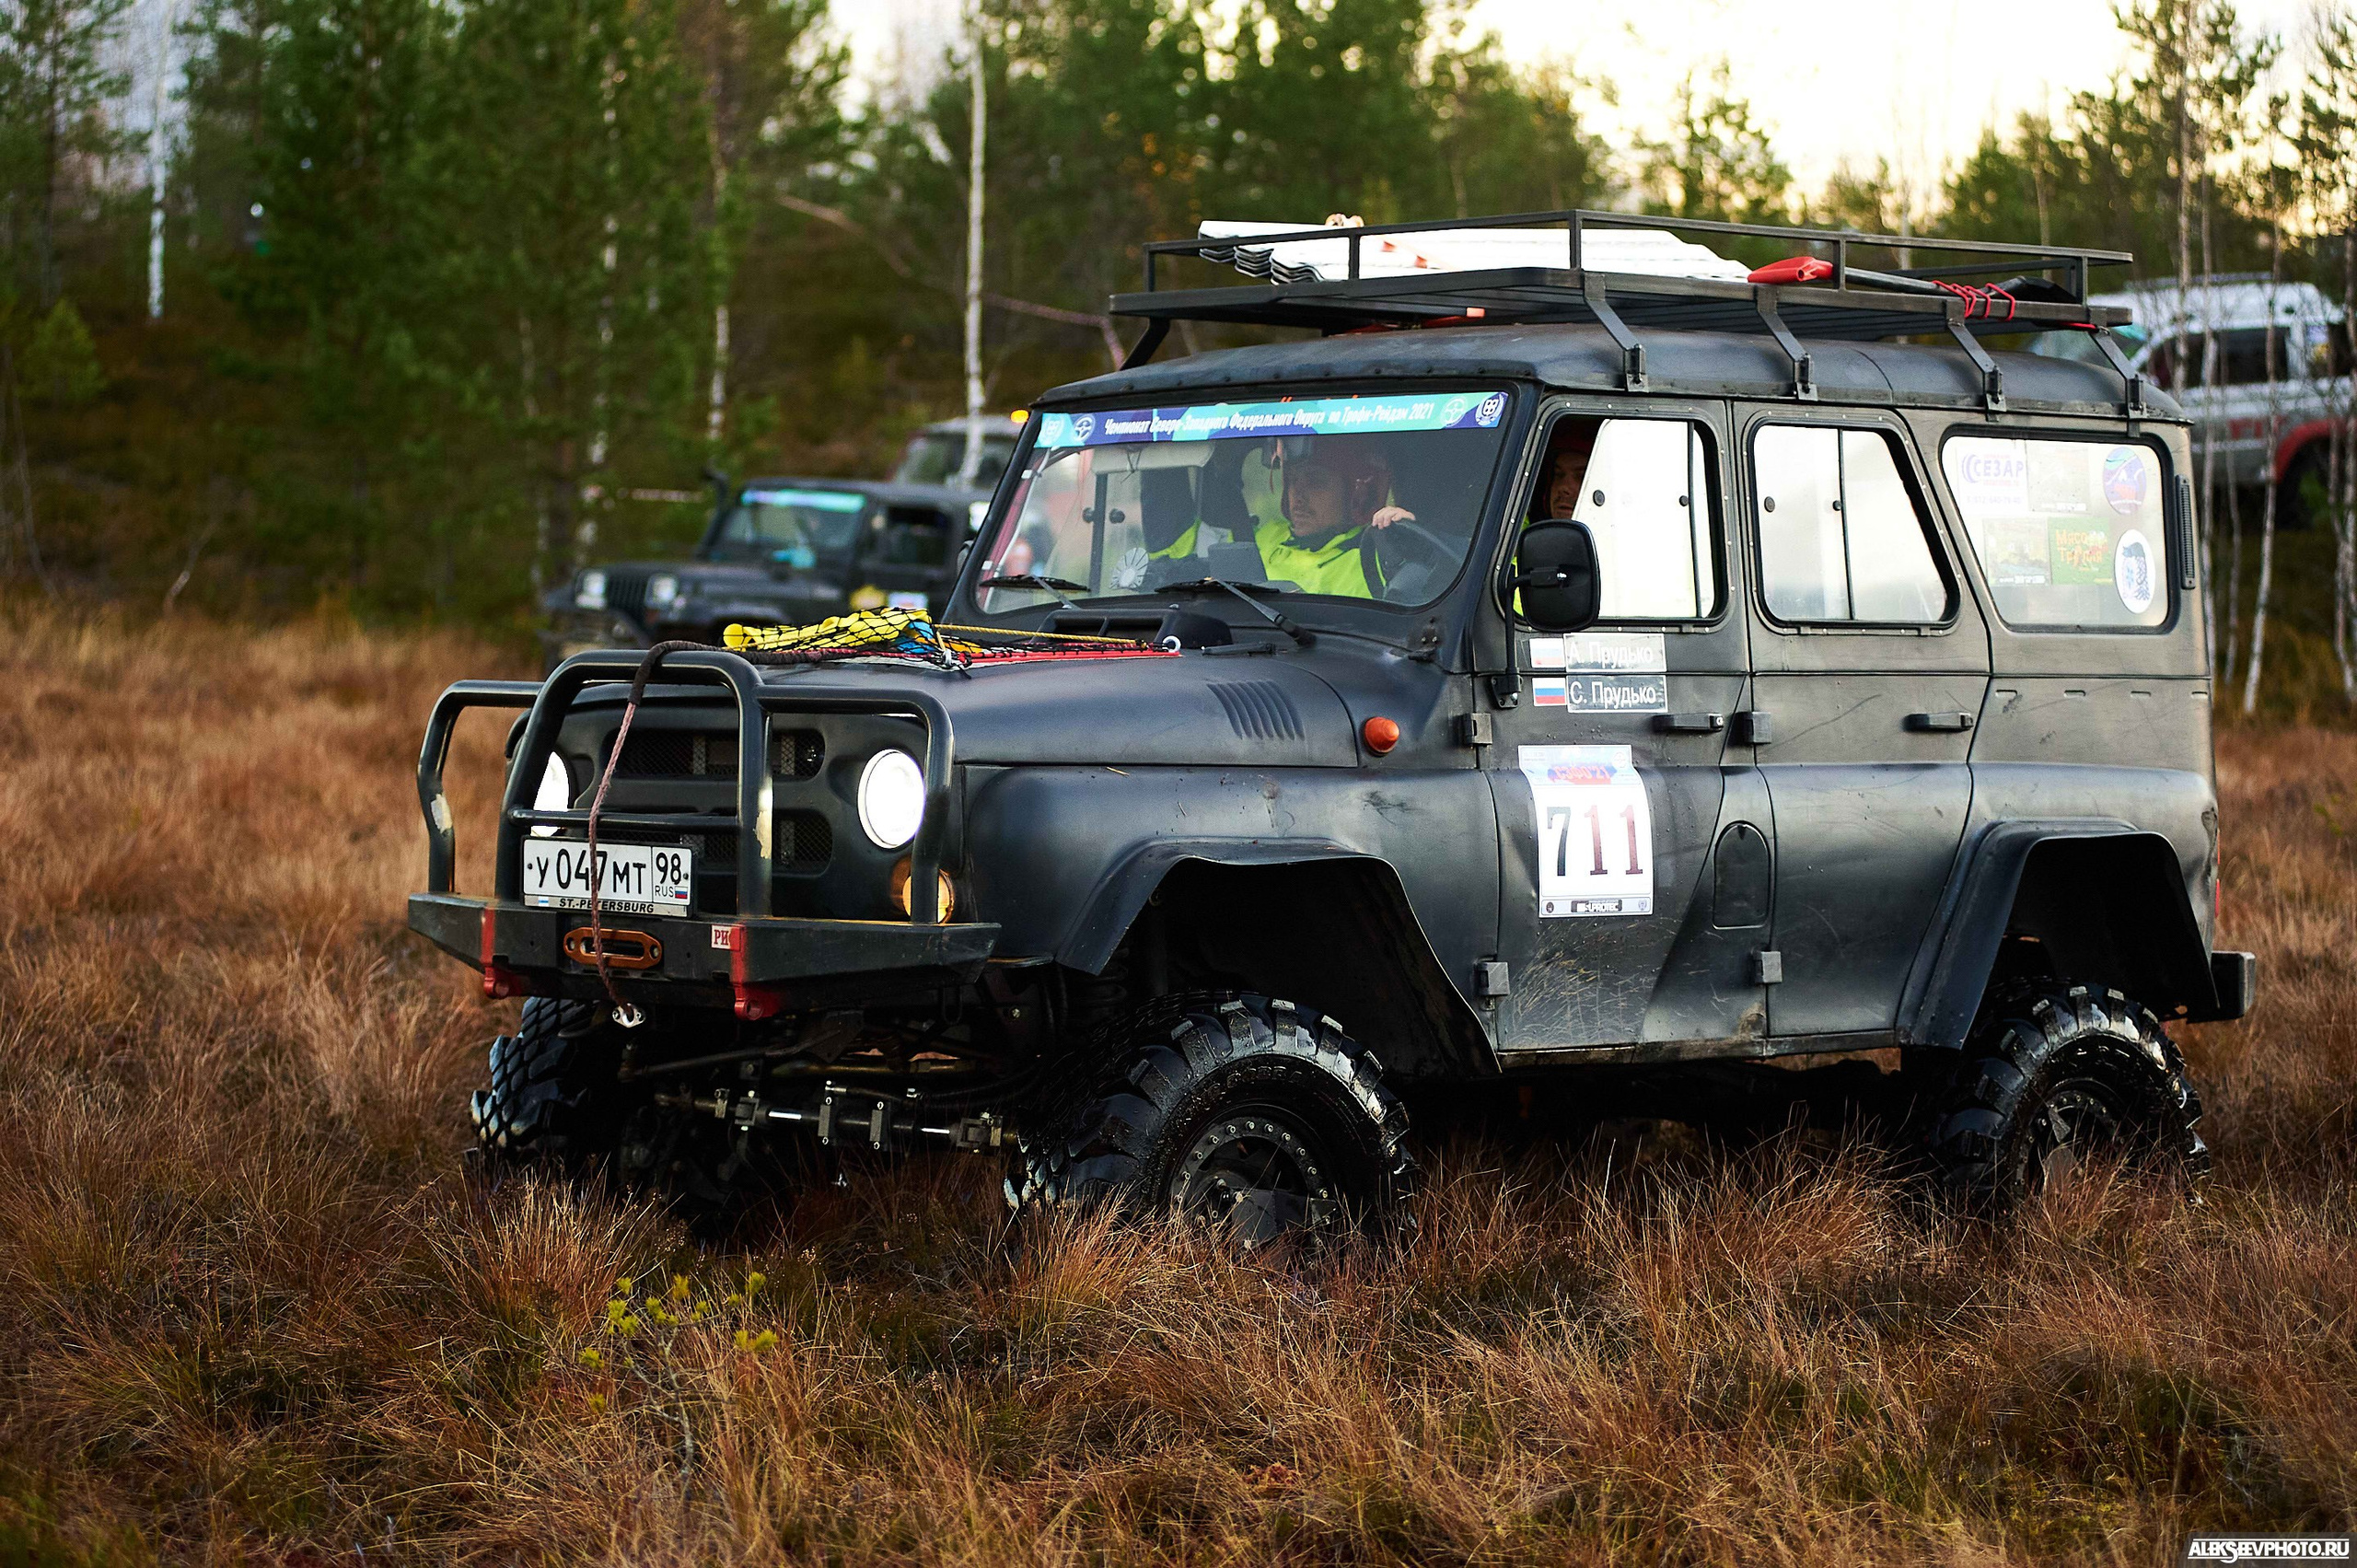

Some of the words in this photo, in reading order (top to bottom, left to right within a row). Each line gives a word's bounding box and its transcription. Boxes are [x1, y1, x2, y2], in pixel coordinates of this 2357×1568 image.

[1105, 418, 1151, 435] Чемпионат
[1150, 414, 1229, 436] Северо-Западного
[1229, 412, 1294, 431] Федерального
[1294, 408, 1323, 428] Округа
[1341, 404, 1409, 426] Трофи-Рейдам
[1409, 402, 1434, 420] 2021
[1569, 642, 1584, 664] А.
[1589, 642, 1654, 669] Прудько
[1570, 681, 1587, 704] С.
[1591, 681, 1656, 709] Прудько
[1547, 805, 1643, 877] 711
[656, 852, 681, 885] 98
[655, 885, 674, 898] RUS
